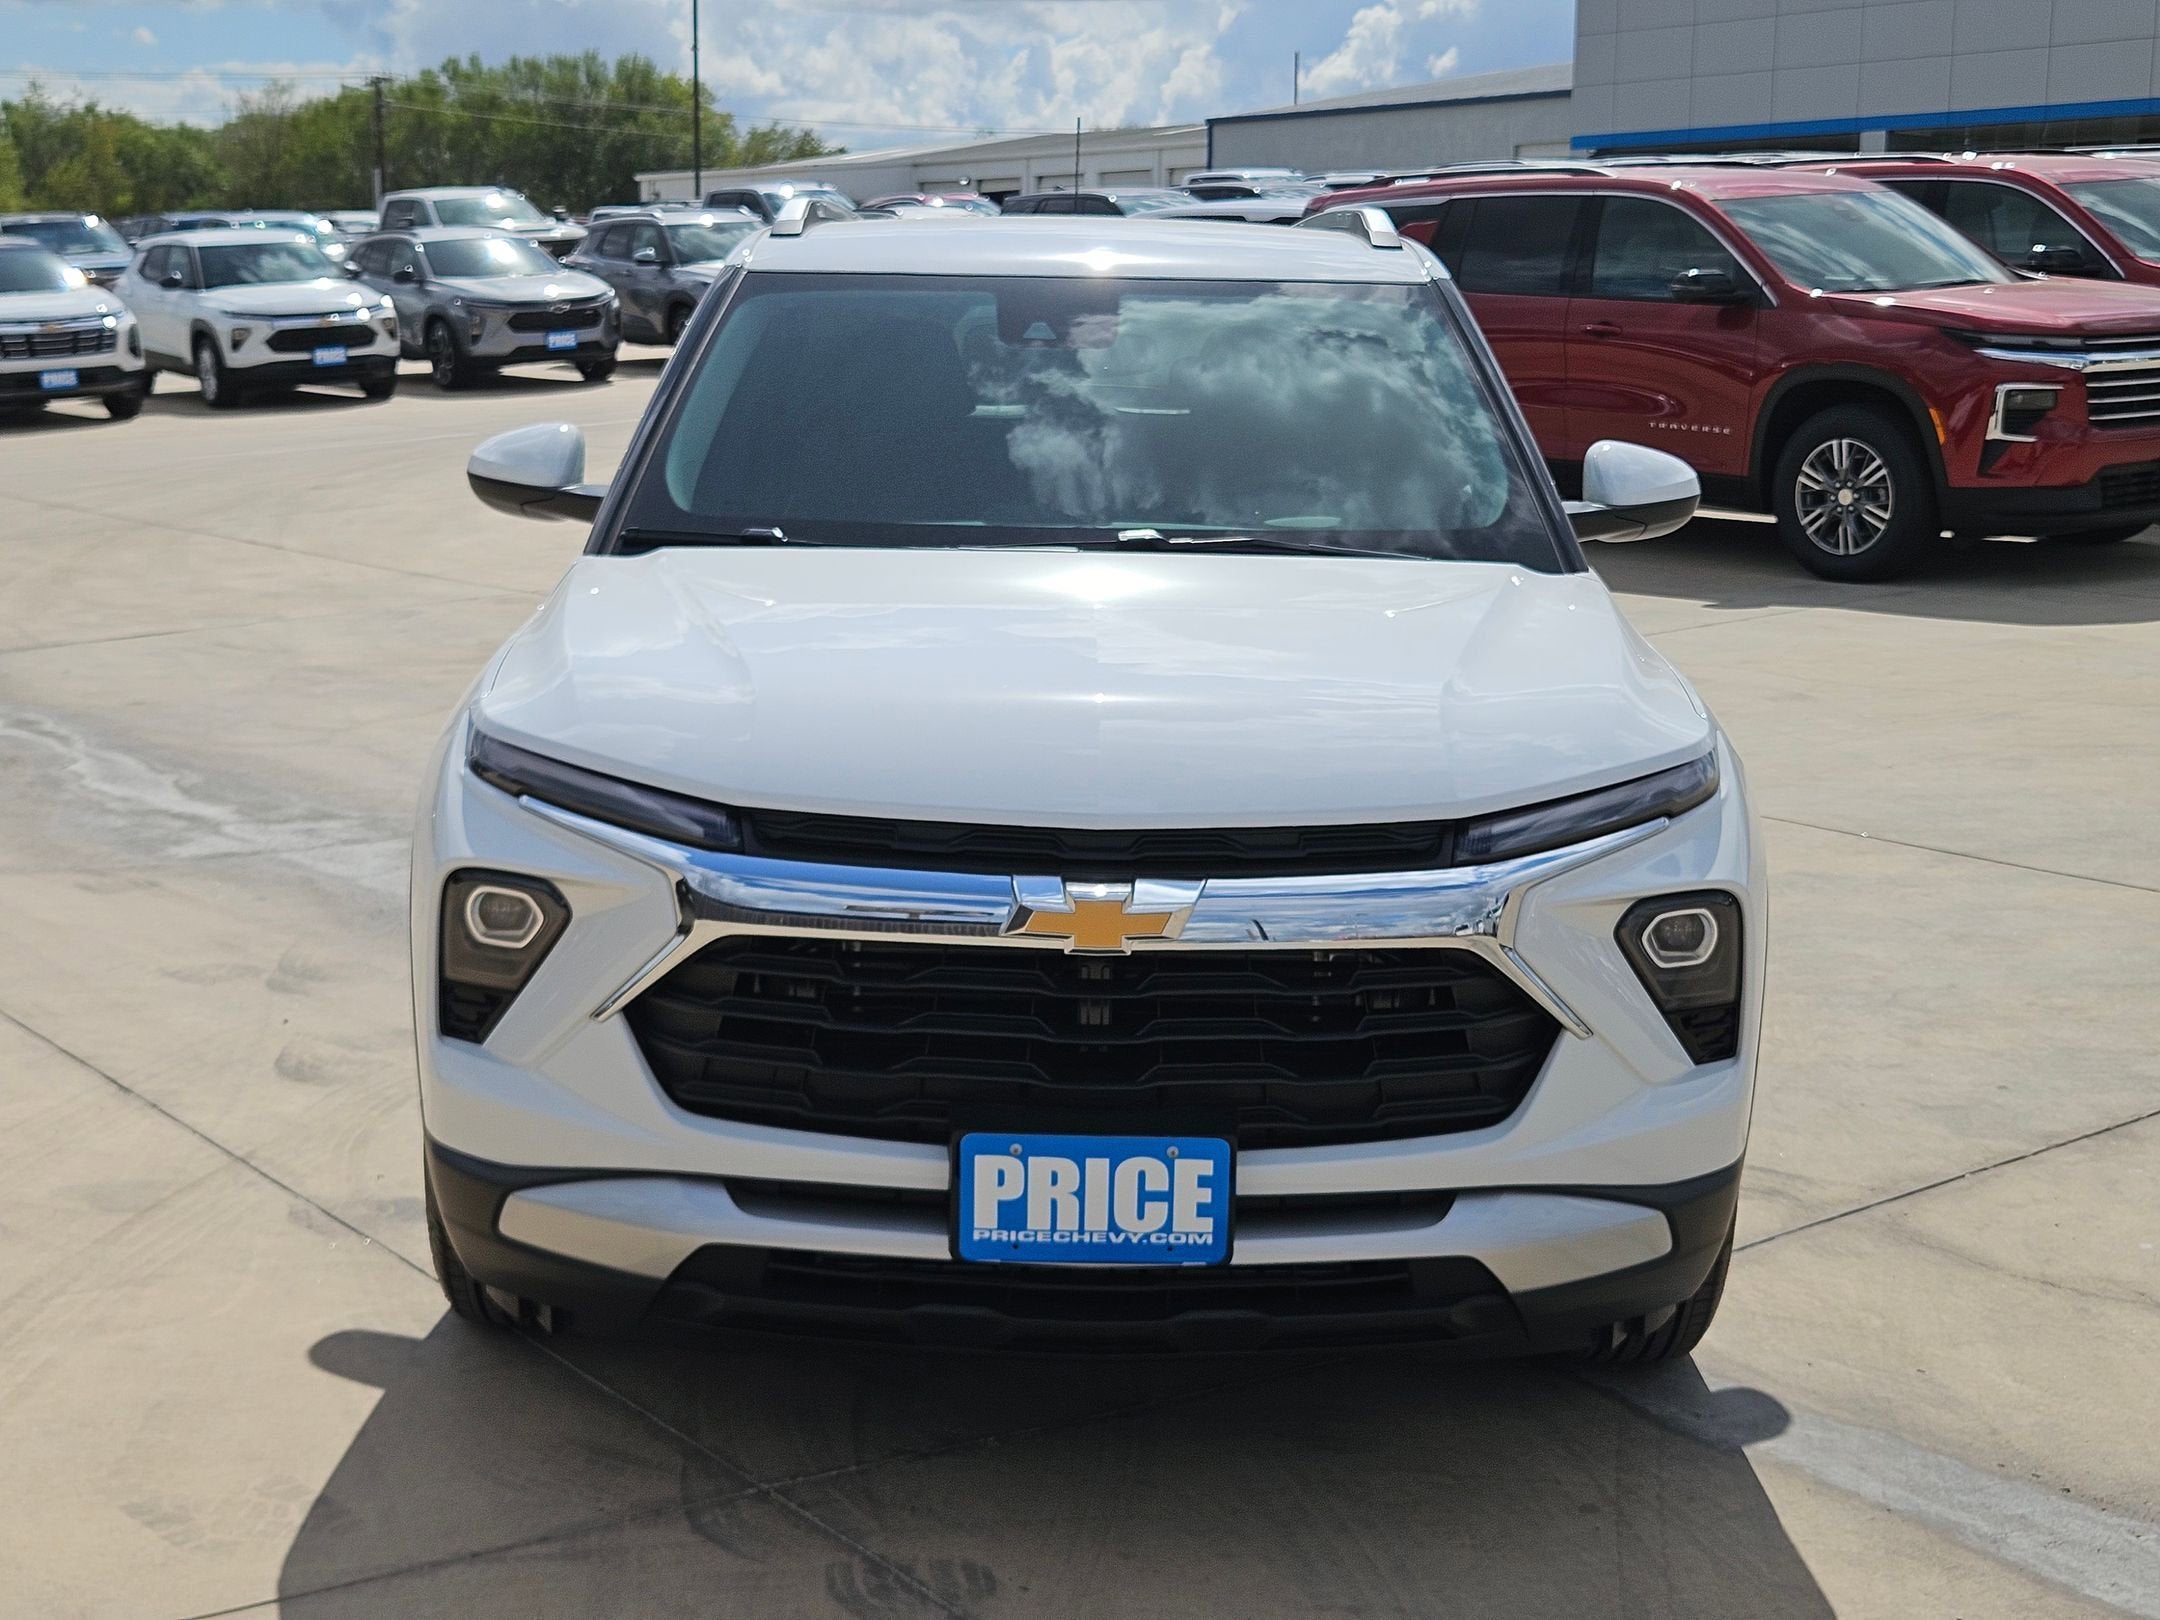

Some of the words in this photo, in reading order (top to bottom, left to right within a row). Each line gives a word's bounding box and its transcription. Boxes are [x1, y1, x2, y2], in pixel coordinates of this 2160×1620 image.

[1649, 422, 1731, 435] TRAVERSE
[974, 1154, 1214, 1233] PRICE
[972, 1229, 1213, 1245] PRICECHEVY.COM
